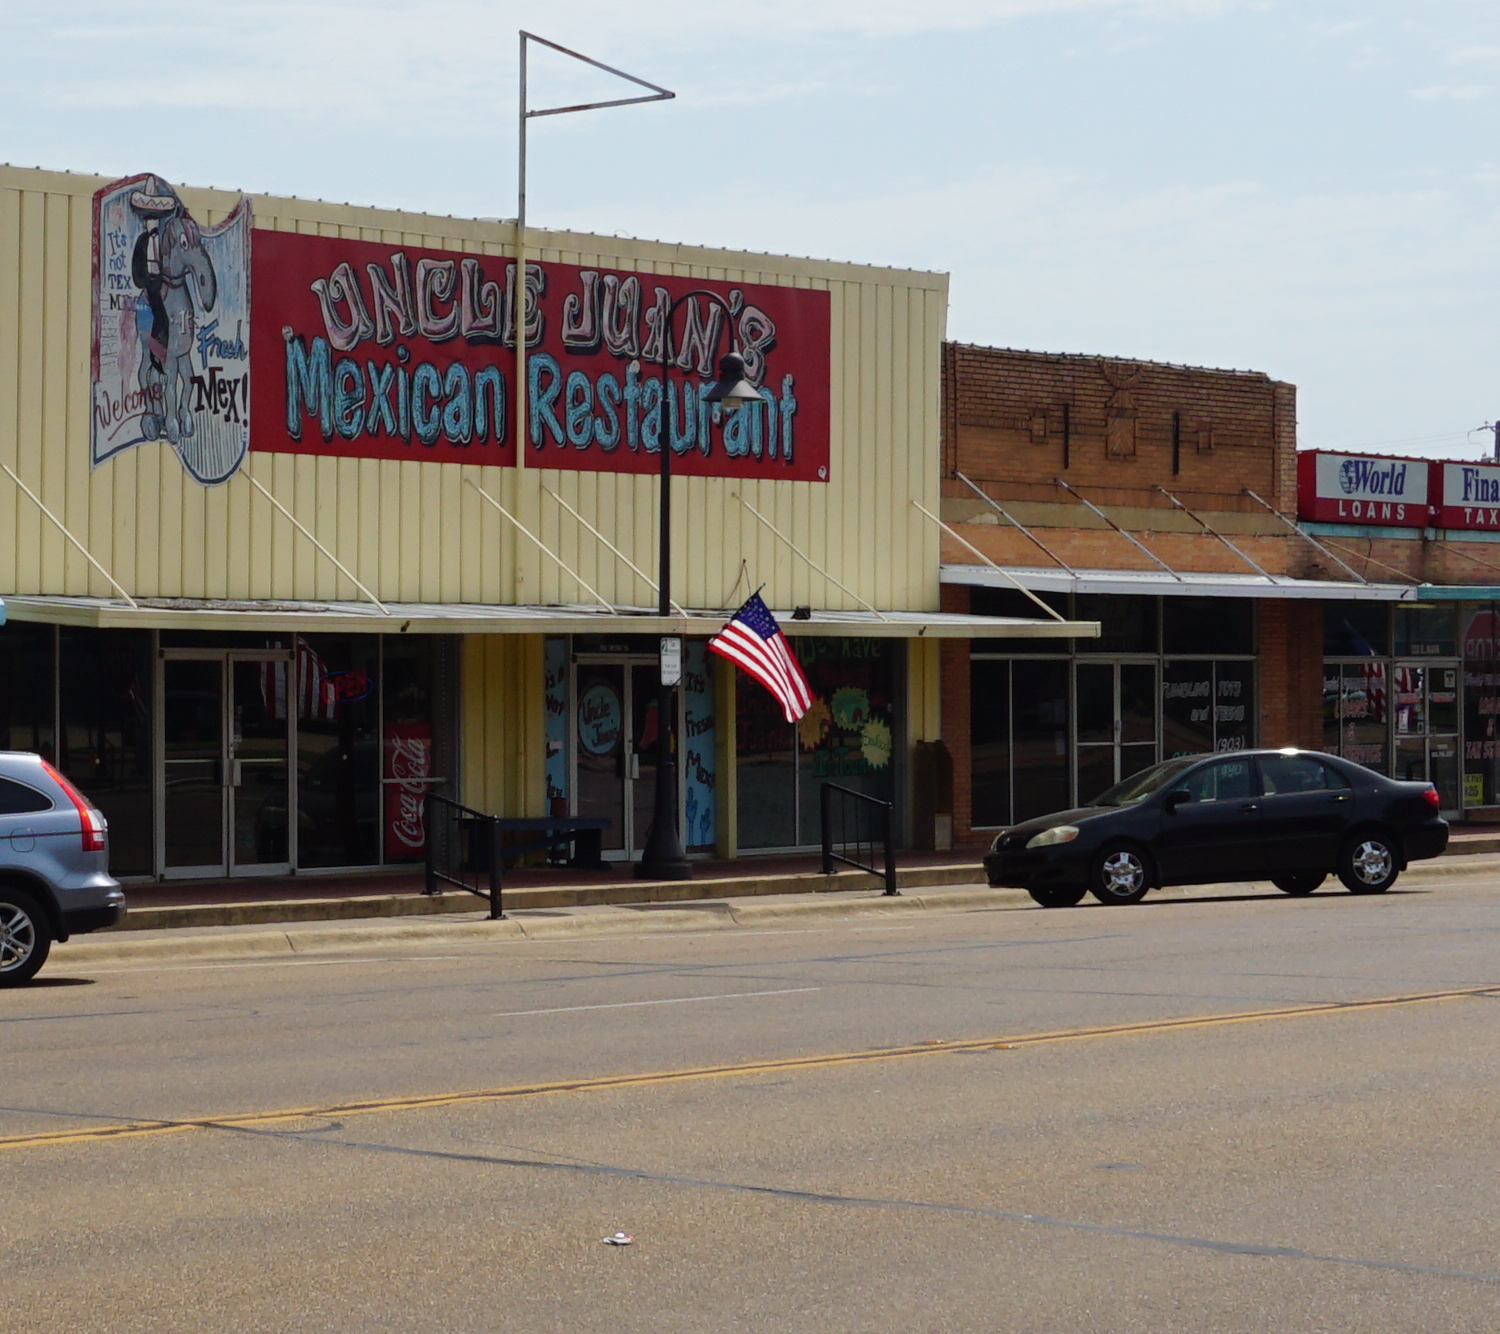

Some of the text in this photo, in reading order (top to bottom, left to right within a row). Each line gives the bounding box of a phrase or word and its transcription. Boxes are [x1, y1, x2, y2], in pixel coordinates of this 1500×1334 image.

[108, 274, 132, 290] TEX
[196, 319, 248, 370] Fresh
[311, 252, 777, 387] UNCLE JUAN'S
[94, 380, 163, 429] Welcome
[191, 367, 248, 428] Mex!
[282, 327, 798, 464] Mexican Restaurant
[1354, 460, 1406, 496] World
[1338, 499, 1405, 520] LOANS
[1217, 735, 1246, 752] (903)
[391, 732, 426, 848] Coca-Cola
